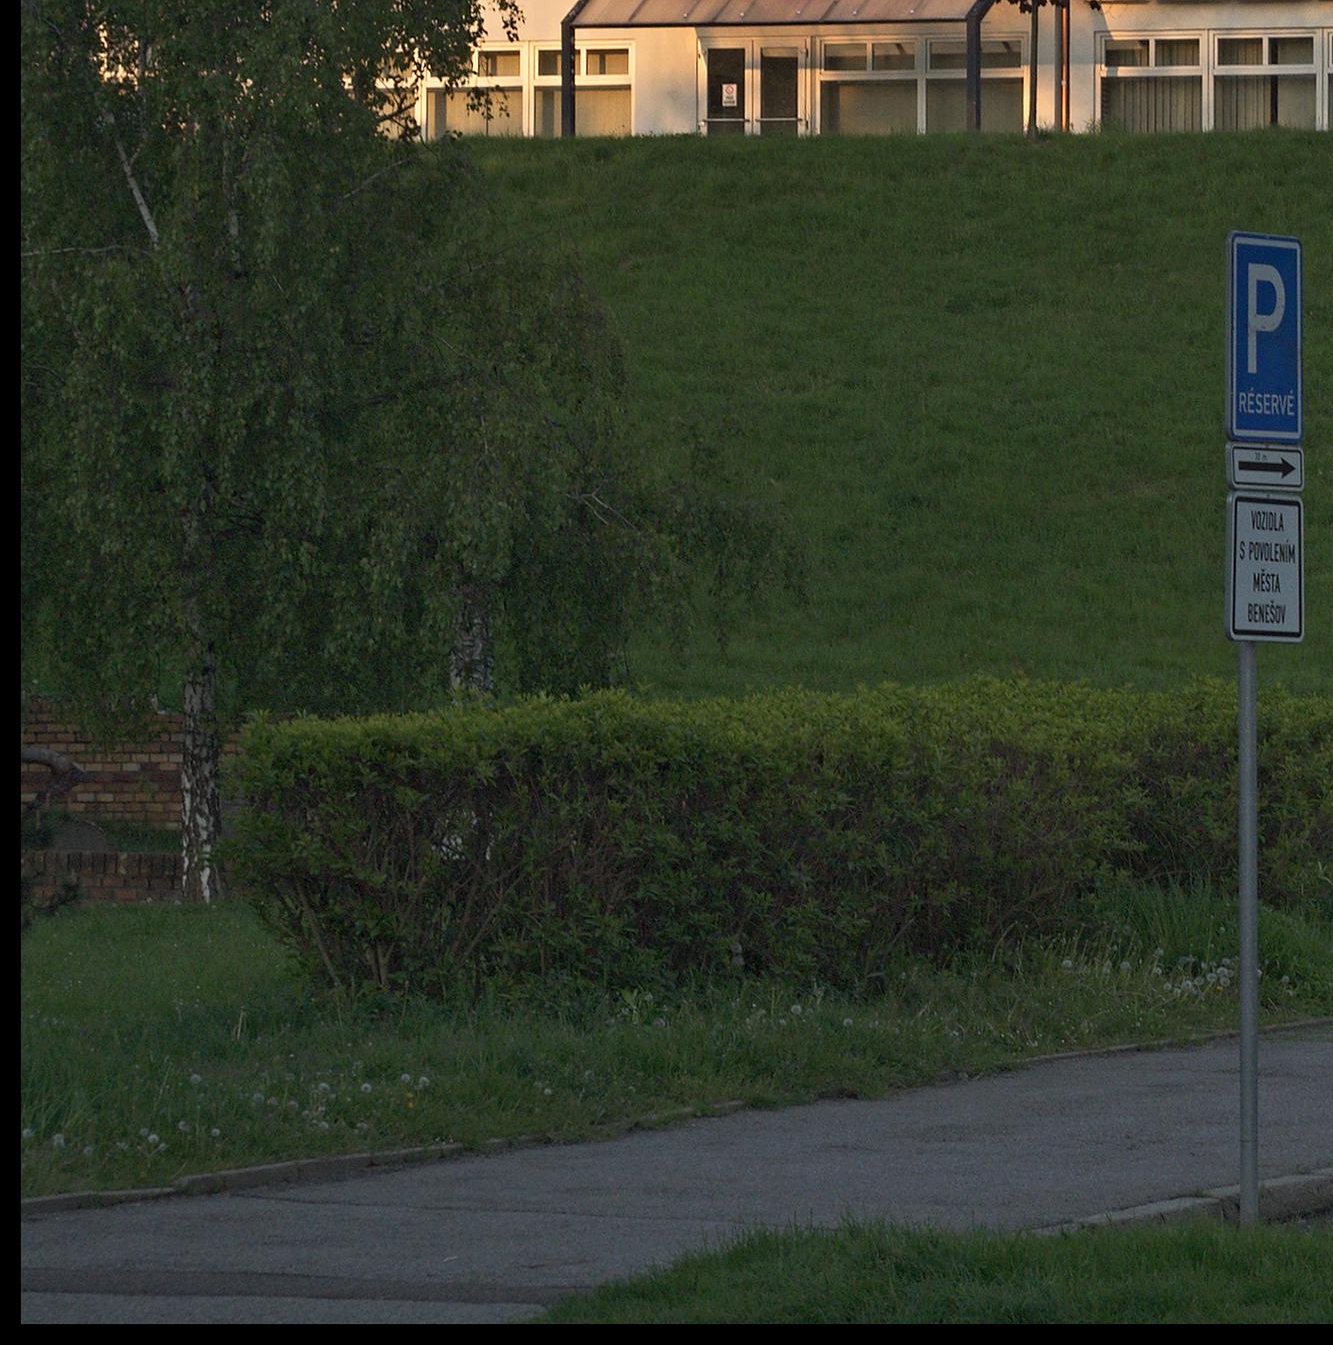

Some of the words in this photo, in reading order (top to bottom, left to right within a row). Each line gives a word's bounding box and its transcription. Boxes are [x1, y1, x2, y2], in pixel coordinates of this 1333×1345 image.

[1247, 262, 1286, 374] P
[1239, 387, 1296, 416] RÉSERVÉ
[1250, 510, 1285, 532] VOZIDLA
[1239, 540, 1246, 561] S
[1248, 538, 1296, 564] POVOLENÍM
[1252, 568, 1281, 593] MĚSTA
[1247, 600, 1287, 625] BENEŠOV
